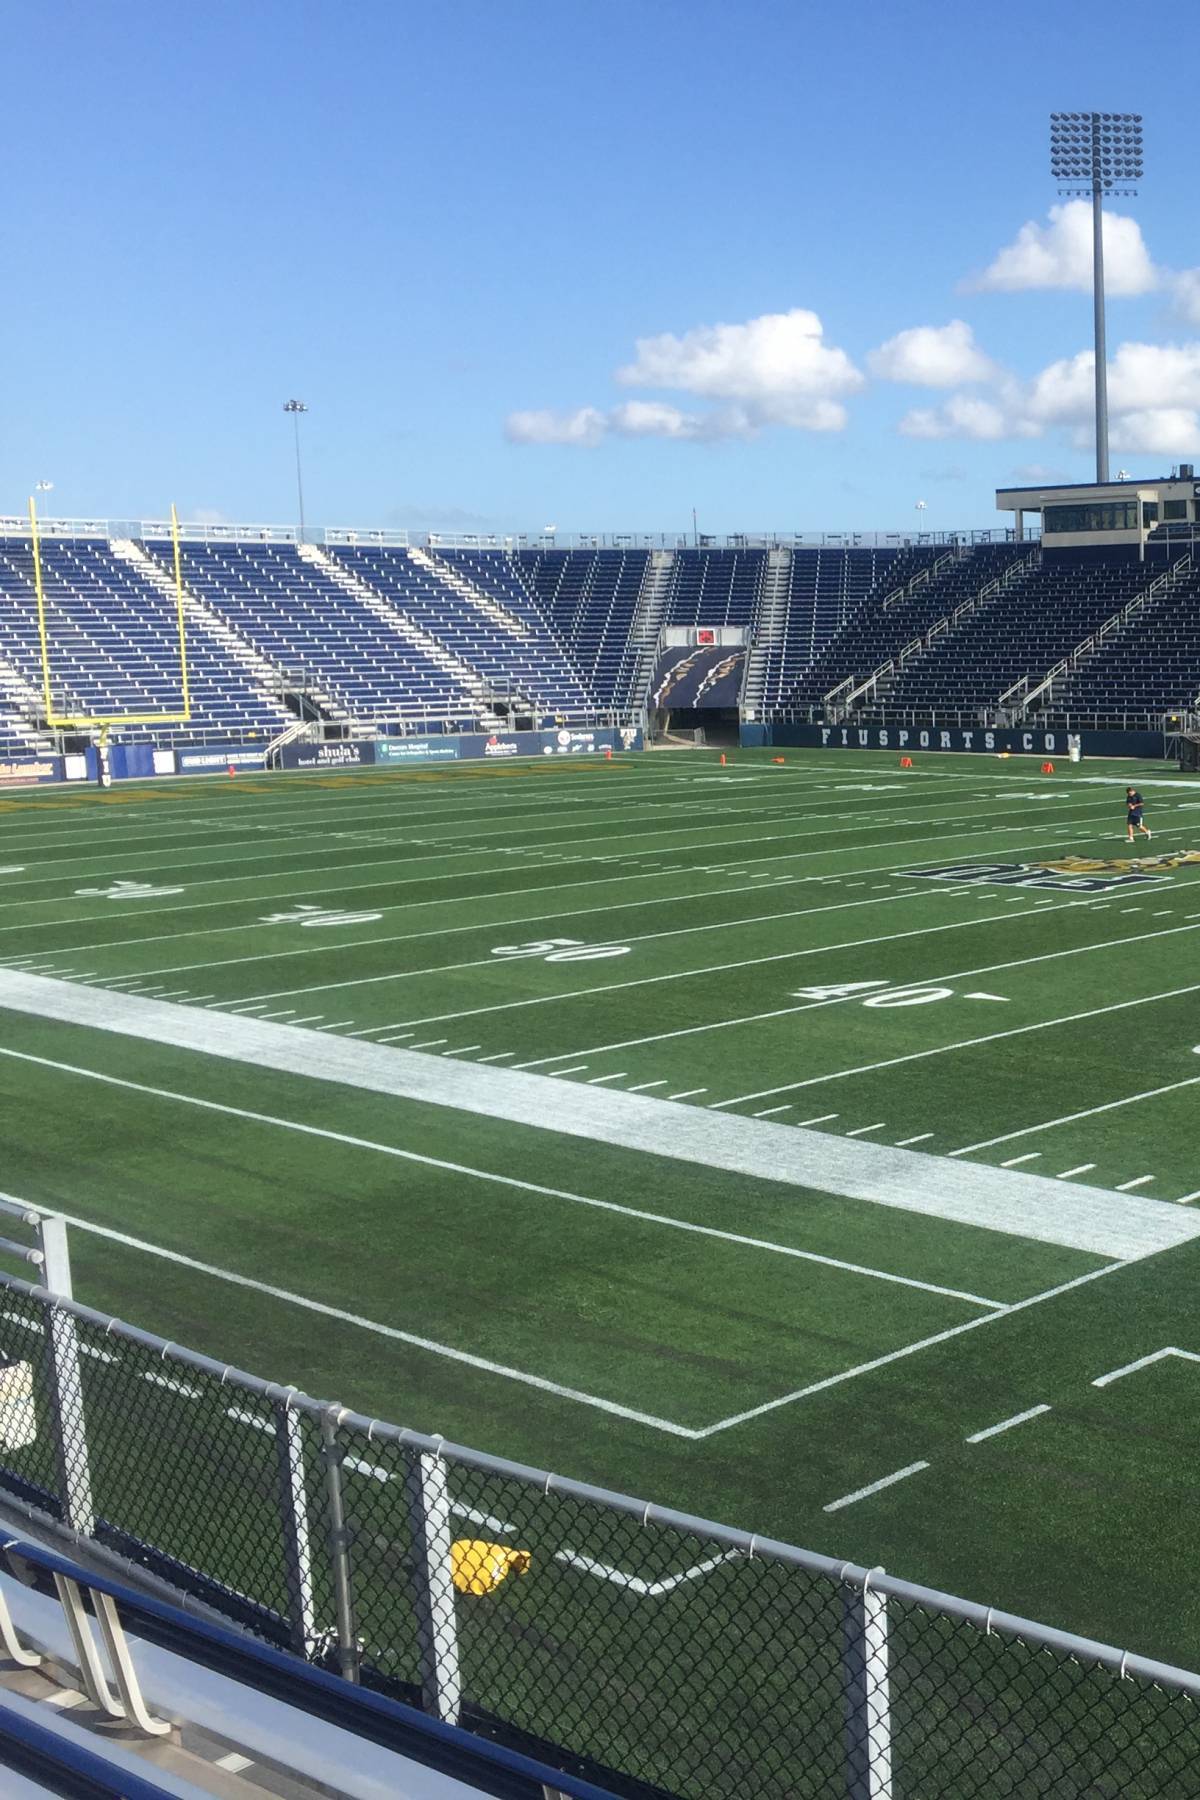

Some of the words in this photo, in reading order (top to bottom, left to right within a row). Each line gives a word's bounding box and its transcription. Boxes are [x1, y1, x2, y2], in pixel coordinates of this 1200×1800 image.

[318, 744, 360, 758] shula's
[298, 758, 316, 766] hotel
[491, 939, 632, 961] 50
[787, 980, 954, 1008] 40
